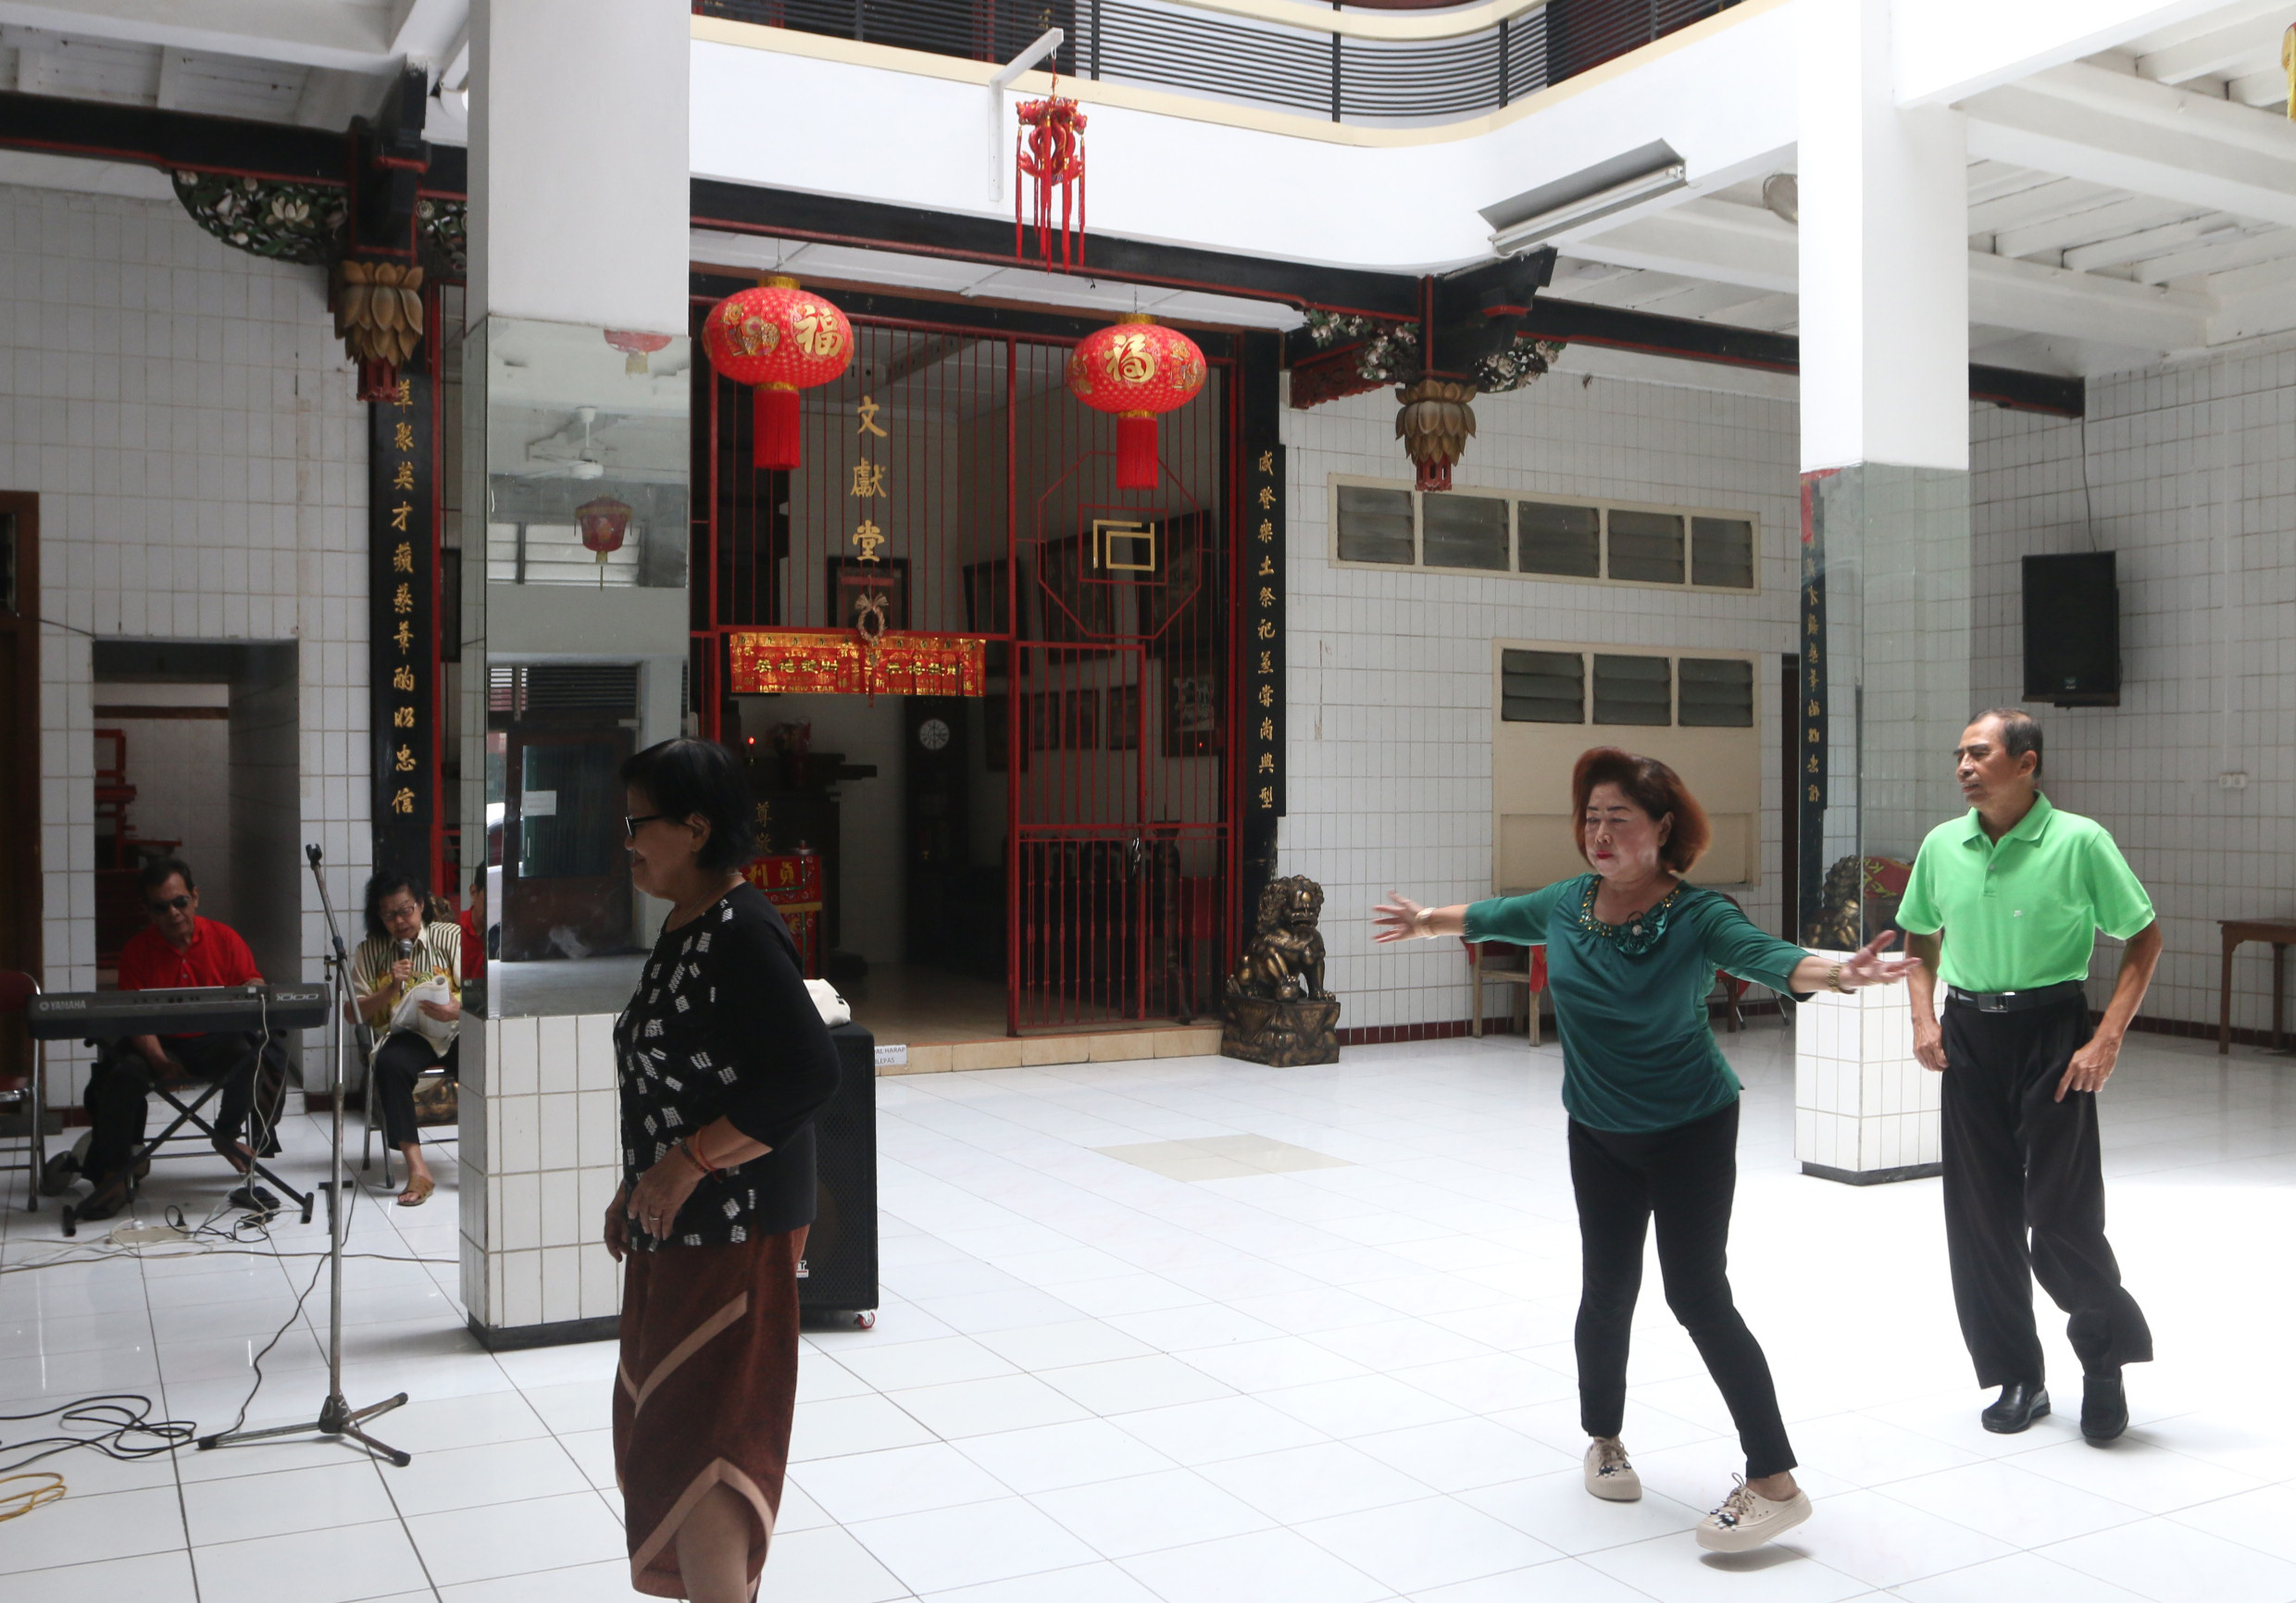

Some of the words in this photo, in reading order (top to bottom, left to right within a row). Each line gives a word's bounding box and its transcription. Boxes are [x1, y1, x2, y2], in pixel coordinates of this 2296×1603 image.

[793, 304, 843, 356] 福
[850, 394, 888, 562] 文獻堂
[50, 1000, 86, 1011] YAMAHA
